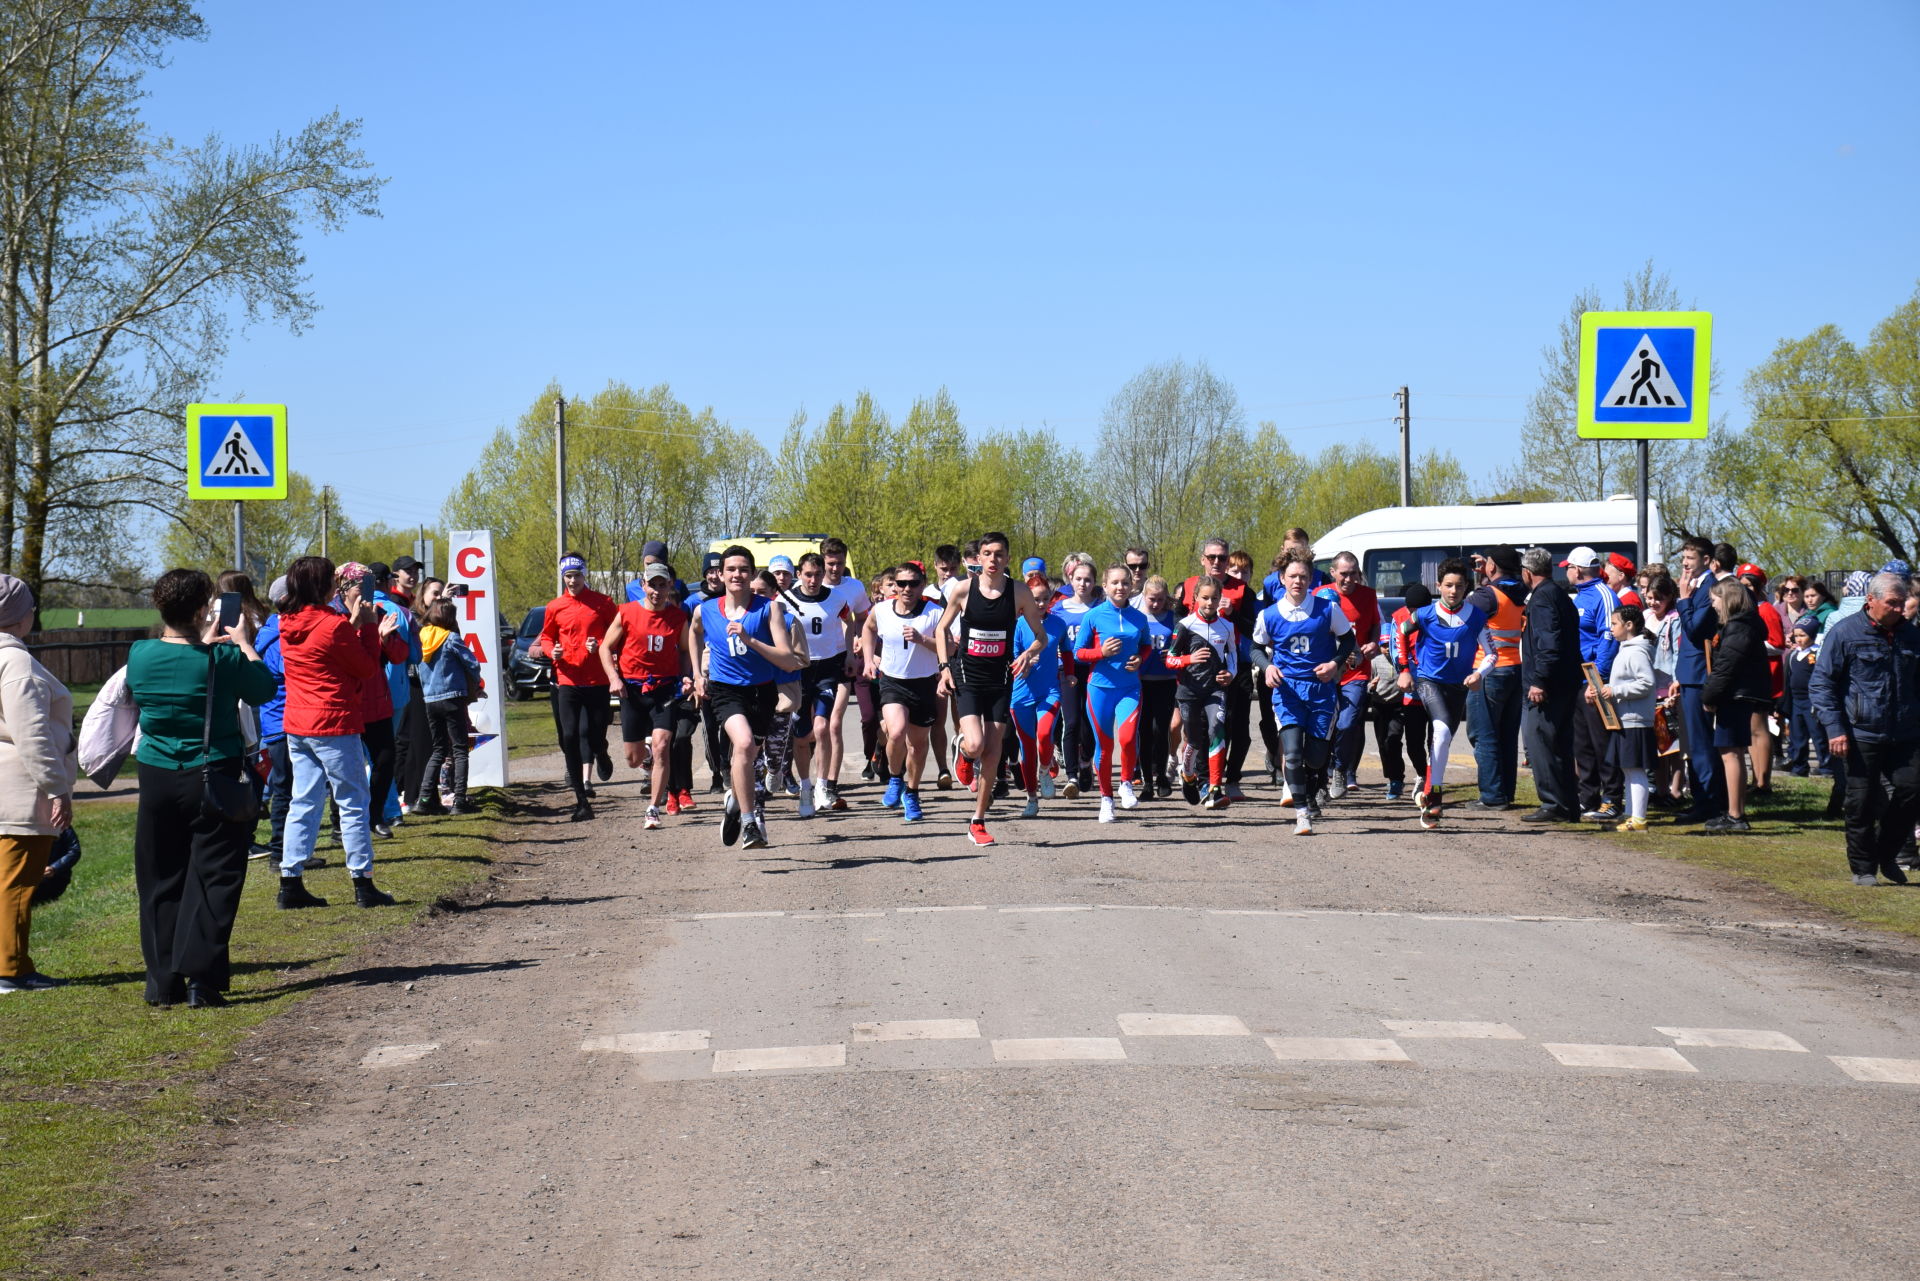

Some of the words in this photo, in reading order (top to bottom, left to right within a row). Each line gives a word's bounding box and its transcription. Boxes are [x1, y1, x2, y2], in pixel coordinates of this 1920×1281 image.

[456, 547, 488, 692] СТА
[812, 617, 822, 635] 6
[647, 635, 664, 652] 19
[727, 636, 748, 657] 18
[974, 643, 999, 654] 2200
[1290, 635, 1310, 654] 29
[1444, 641, 1460, 658] 11
